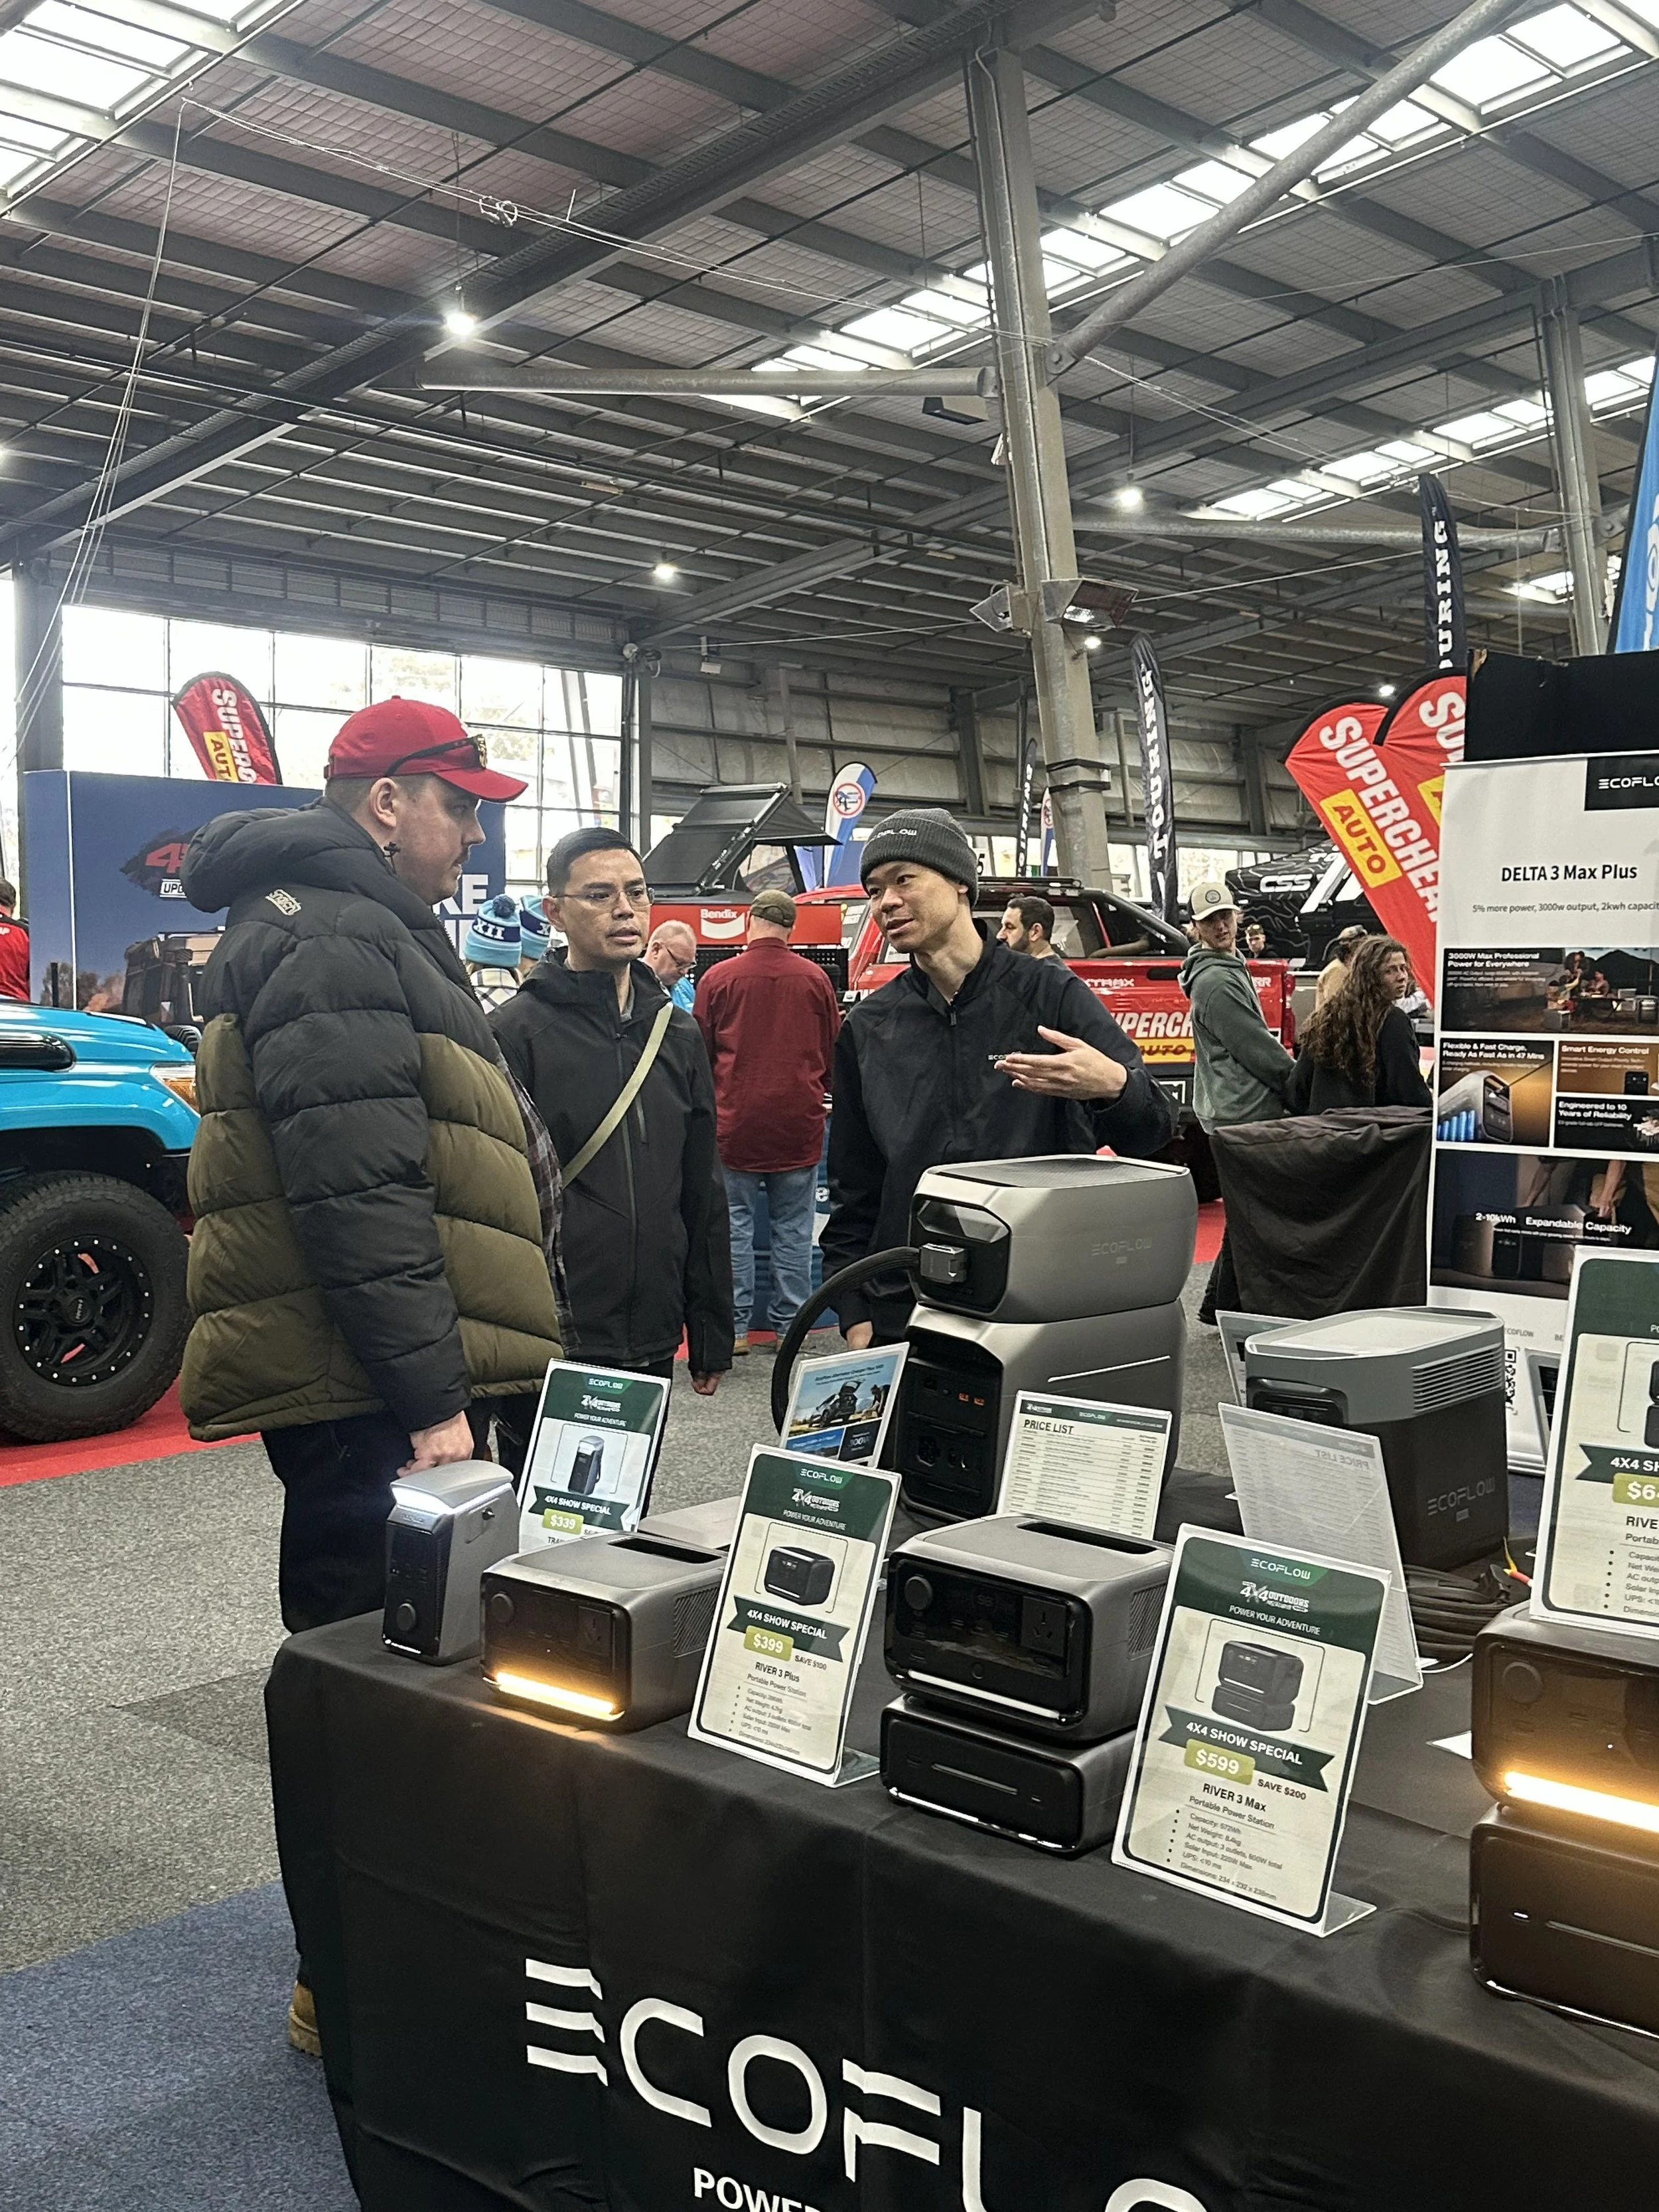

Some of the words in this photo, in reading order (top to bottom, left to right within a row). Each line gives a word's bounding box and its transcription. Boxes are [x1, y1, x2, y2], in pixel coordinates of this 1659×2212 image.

[1141, 669, 1168, 859] TOURING
[1319, 716, 1441, 924] SUPERCHEA
[1332, 805, 1386, 874] AUTO
[1501, 865, 1548, 881] DELTA
[1550, 865, 1559, 880] 3
[1563, 865, 1597, 880] Max
[1601, 863, 1637, 879] Plus
[701, 907, 738, 919] Bendix
[1472, 903, 1485, 913] 5%
[1509, 903, 1537, 914] power,
[1566, 902, 1599, 914] output,
[1601, 901, 1626, 911] 2kwh
[1587, 1046, 1617, 1055] Energy
[1559, 1100, 1605, 1110] Engineered
[1525, 1217, 1583, 1230] Expandable
[1585, 1221, 1632, 1234] Capacity
[1024, 1418, 1052, 1432] PRICE
[1052, 1424, 1075, 1435] LIST
[1610, 1457, 1640, 1470] 4X4
[558, 1497, 581, 1509] SHOW
[581, 1501, 612, 1516] SPECIAL
[1427, 1476, 1496, 1516] ECOFLOW
[549, 1514, 576, 1530] $339
[1250, 1558, 1311, 1580] ECOFLOW
[747, 1609, 763, 1621] 4X4
[763, 1613, 791, 1629] SHOW
[790, 1621, 828, 1640] SPECIAL
[1229, 1605, 1256, 1619] POWER
[1256, 1611, 1276, 1624] YOUR
[1275, 1617, 1321, 1636] ADVENTURE
[753, 1633, 784, 1654] $399
[794, 1655, 812, 1666] SAVE
[755, 1661, 778, 1675] RIVER
[778, 1669, 783, 1678] 3
[784, 1670, 800, 1683] Plus
[1186, 1722, 1208, 1737] 4X4
[1209, 1728, 1249, 1749] SHOW
[1249, 1739, 1303, 1766] SPECIAL
[1195, 1748, 1240, 1775] $599
[1202, 1783, 1236, 1802] RIVER
[1236, 1794, 1243, 1805] 3
[1244, 1796, 1267, 1812] Max
[1257, 1778, 1283, 1793] SAVE
[1283, 1786, 1307, 1801] $200
[1189, 1795, 1222, 1812] Portable
[1222, 1805, 1246, 1820] Power
[1247, 1814, 1275, 1830] Station
[1185, 1832, 1196, 1841] AC
